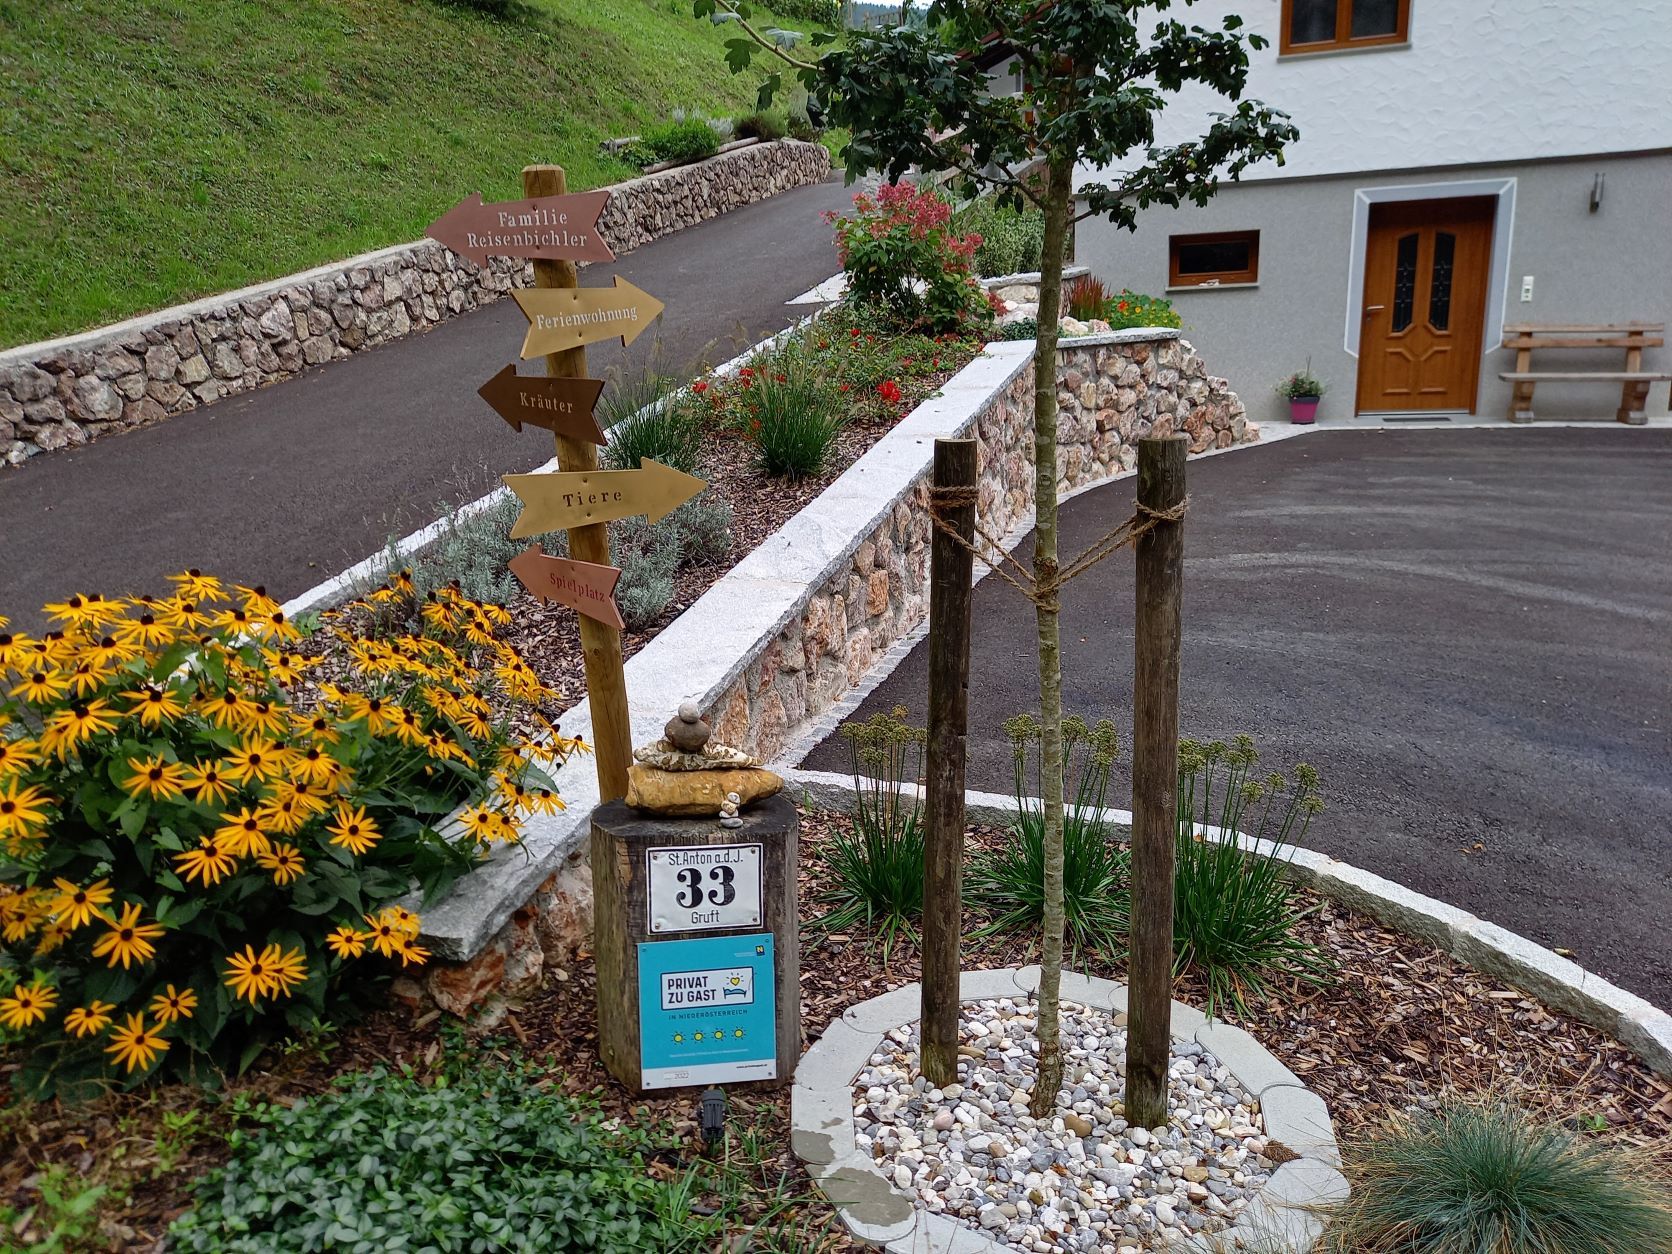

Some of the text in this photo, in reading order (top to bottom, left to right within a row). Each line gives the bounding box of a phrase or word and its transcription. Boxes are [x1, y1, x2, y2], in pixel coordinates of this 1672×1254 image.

[498, 209, 568, 228] Familie
[467, 231, 587, 249] Reisenbichler
[536, 306, 638, 330] Ferienwohnung
[519, 392, 573, 414] Kräuter
[562, 491, 622, 507] Tiere
[550, 573, 605, 602] Spielplatz
[676, 865, 736, 909] 33
[691, 910, 720, 924] Gruft
[667, 976, 709, 990] PRIVAT
[667, 989, 717, 1004] ZU GAST
[678, 1009, 748, 1020] NIEDERÖSTERREICH
